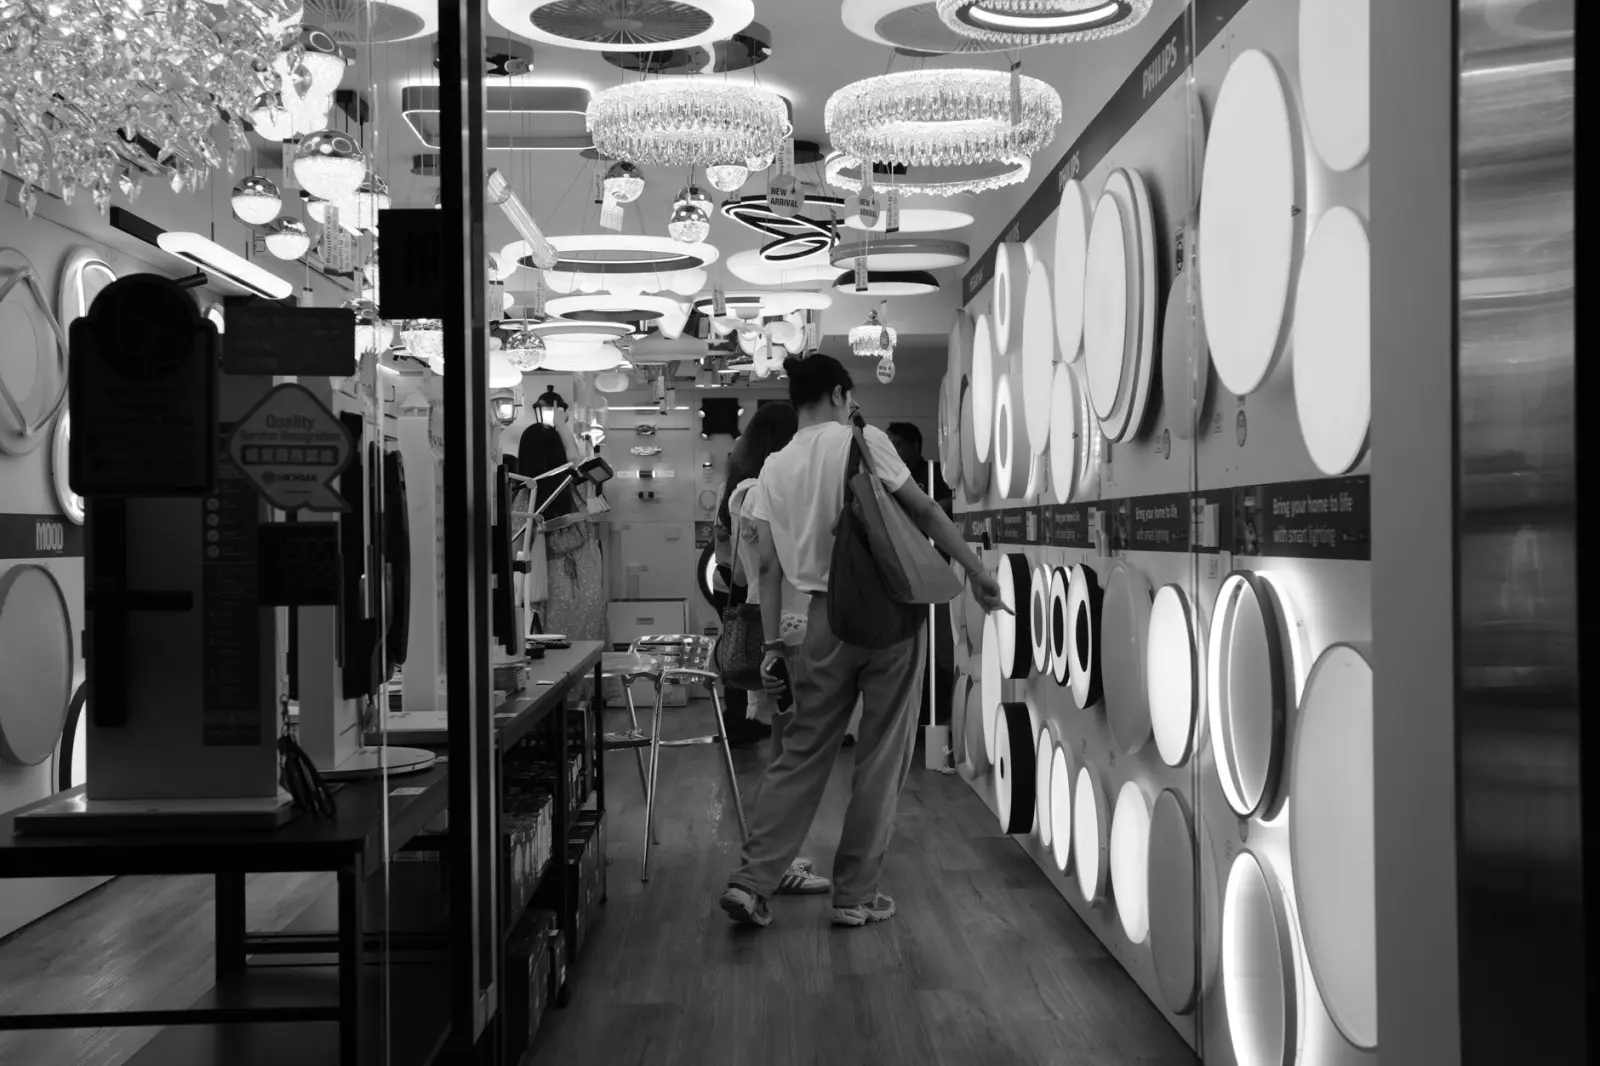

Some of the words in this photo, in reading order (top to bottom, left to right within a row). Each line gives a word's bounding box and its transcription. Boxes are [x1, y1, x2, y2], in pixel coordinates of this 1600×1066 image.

[1142, 36, 1177, 99] PHILIPS
[771, 187, 788, 196] NEW
[770, 197, 798, 208] ARRIVAL
[860, 198, 870, 207] NEW
[265, 414, 315, 432] Quality
[1273, 497, 1290, 519] Bring
[1290, 500, 1307, 519] your
[1307, 494, 1329, 515] home
[1329, 495, 1339, 513] to
[1339, 491, 1353, 513] life
[36, 522, 64, 551] MOOD
[1273, 525, 1288, 544] with
[1288, 527, 1308, 544] smart
[1308, 524, 1336, 548] lighting
